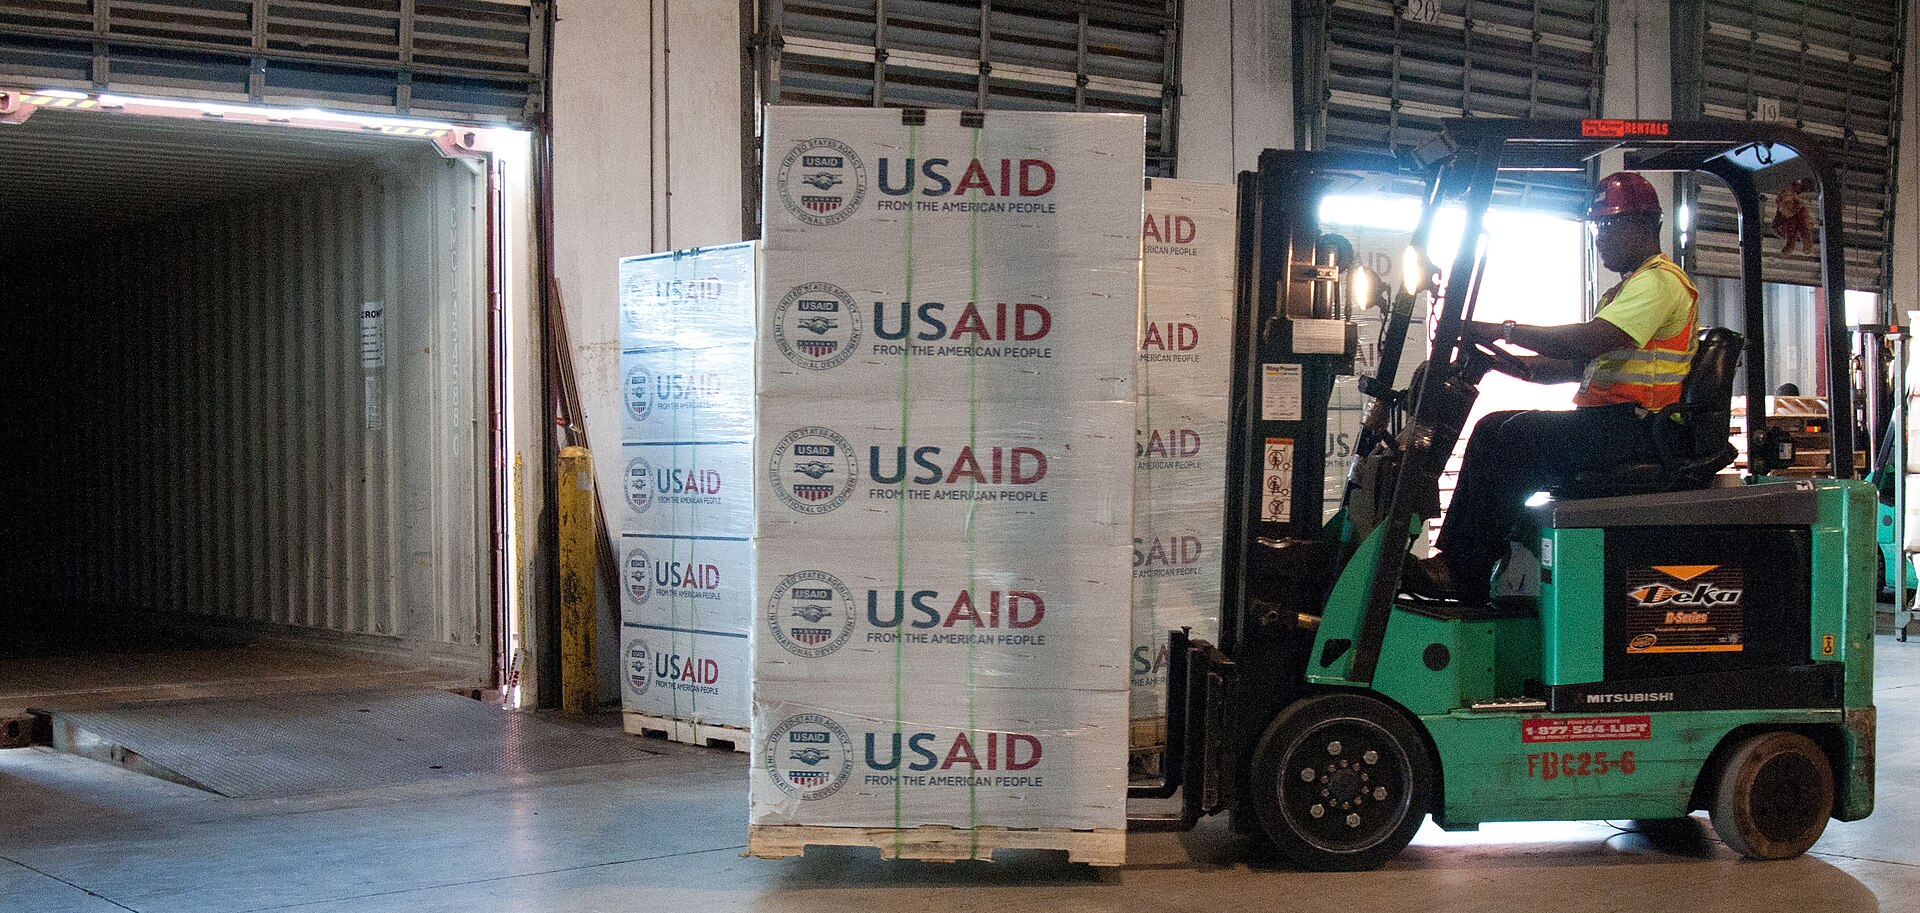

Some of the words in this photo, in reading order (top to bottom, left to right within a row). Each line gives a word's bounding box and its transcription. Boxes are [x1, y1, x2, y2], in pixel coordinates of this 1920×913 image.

[1411, 0, 1436, 22] 20
[1762, 103, 1777, 122] 19
[806, 157, 838, 167] USAID
[838, 144, 862, 169] AGENCY
[877, 158, 1056, 197] USAID
[878, 201, 913, 211] FROM
[917, 202, 939, 212] THE
[940, 202, 1006, 213] AMERICAN
[1009, 203, 1056, 214] PEOPLE
[1170, 247, 1197, 256] PEOPLE
[802, 301, 834, 311] USAID
[834, 289, 859, 313] AGENCY
[874, 301, 1052, 342] USAID
[874, 345, 909, 355] FROM
[913, 346, 935, 356] THE
[936, 346, 1000, 357] AMERICAN
[1005, 347, 1052, 358] PEOPLE
[1173, 355, 1200, 363] PEOPLE
[657, 374, 721, 400] USAID
[797, 446, 830, 455] USAID
[829, 432, 853, 457] AGENCY
[869, 445, 1048, 485] USAID
[1138, 461, 1174, 470] AMERICAN
[1175, 461, 1201, 469] PEOPLE
[657, 468, 721, 494] USAID
[658, 496, 671, 504] FROM
[870, 489, 904, 499] FROM
[908, 489, 930, 500] THE
[933, 490, 997, 501] AMERICAN
[1001, 491, 1048, 502] PEOPLE
[656, 561, 720, 590] USAID
[1139, 569, 1175, 578] AMERICAN
[1176, 567, 1202, 576] PEOPLE
[679, 590, 703, 599] AMERICAN
[703, 592, 720, 600] PEOPLE
[795, 590, 828, 599] USAID
[827, 576, 851, 601] AGENCY
[1630, 583, 1742, 607] Deka
[867, 590, 1046, 629] USAID
[1663, 611, 1709, 625] D-Series
[867, 633, 901, 643] FROM
[905, 634, 927, 644] THE
[930, 634, 994, 645] AMERICAN
[998, 635, 1045, 646] PEOPLE
[656, 652, 719, 685] USAID
[656, 680, 668, 689] FROM
[677, 683, 700, 692] AMERICAN
[701, 686, 719, 695] PEOPLE
[1586, 692, 1674, 704] MITSUBISHI
[793, 733, 825, 742] USAID
[824, 720, 849, 744] AGENCY
[865, 732, 1043, 772] USAID
[865, 775, 900, 786] FROM
[903, 776, 925, 786] THE
[929, 777, 992, 787] AMERICAN
[996, 777, 1043, 788] PEOPLE
